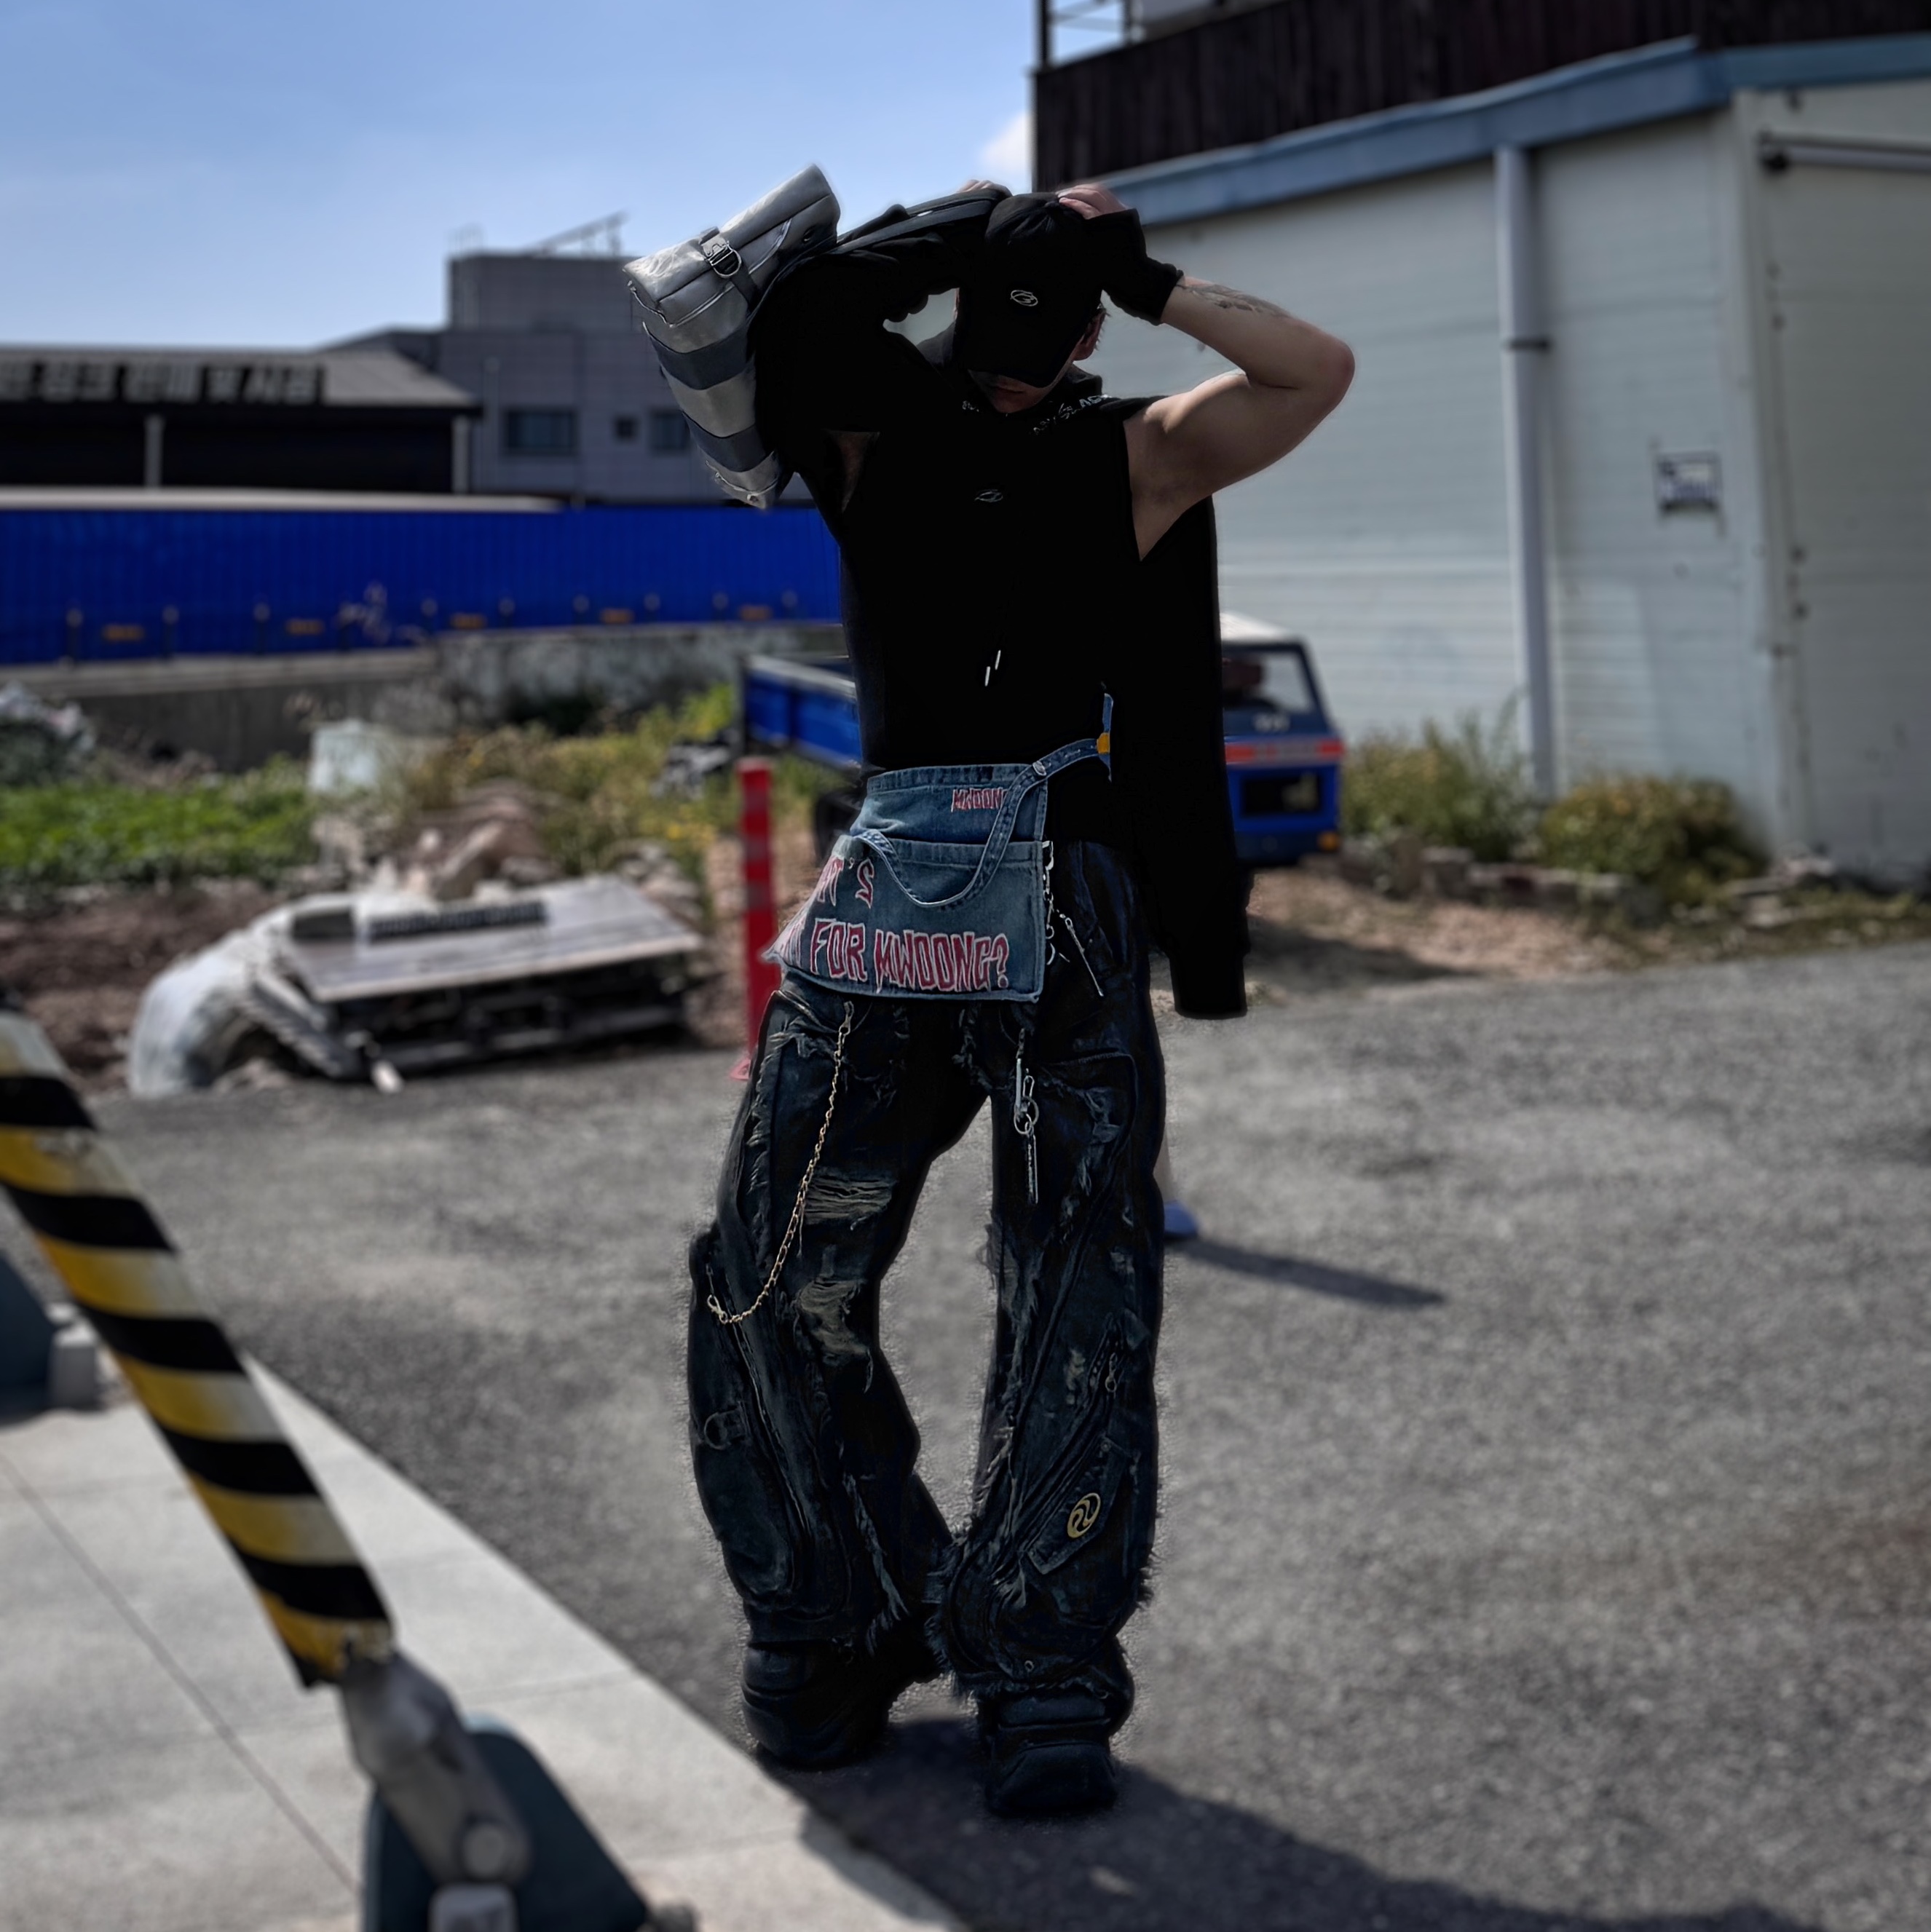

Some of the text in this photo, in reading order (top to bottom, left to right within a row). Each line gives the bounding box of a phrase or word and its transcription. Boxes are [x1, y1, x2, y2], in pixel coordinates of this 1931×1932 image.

[951, 787, 1008, 812] MWOON
[810, 917, 868, 982] FOR
[874, 929, 1009, 993] MWOONG?
